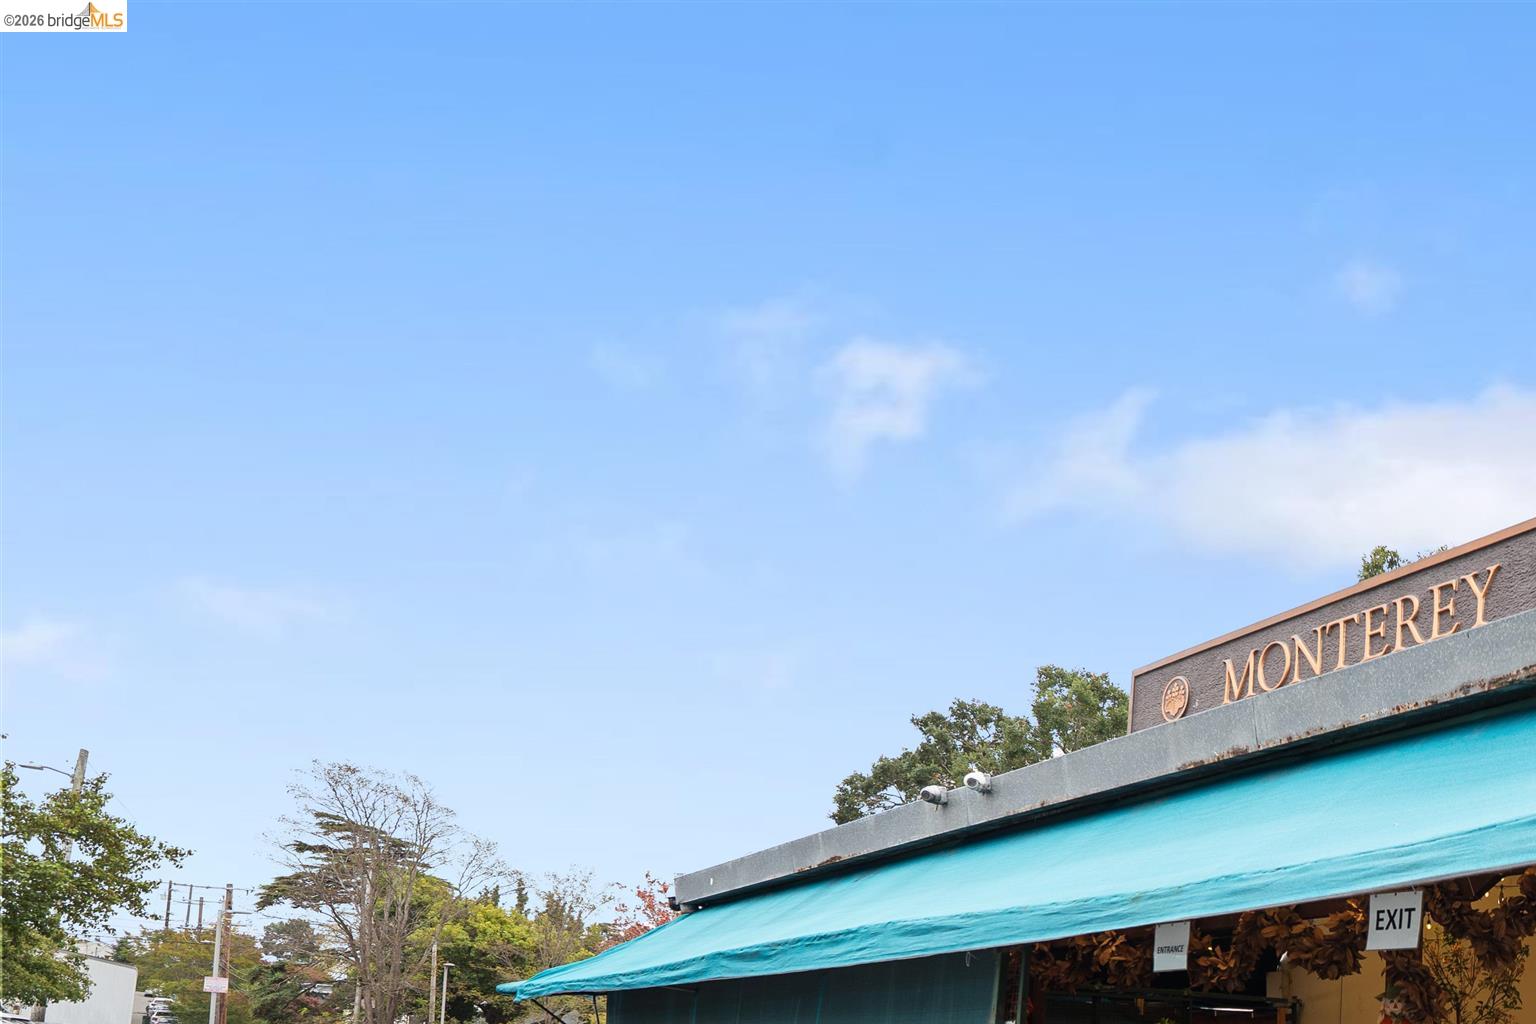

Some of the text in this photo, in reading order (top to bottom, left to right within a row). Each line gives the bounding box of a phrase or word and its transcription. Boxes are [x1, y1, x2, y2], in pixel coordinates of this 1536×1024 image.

[1222, 563, 1502, 705] MONTEREY
[1376, 908, 1416, 930] EXIT
[1157, 945, 1184, 954] ENTRANCE
